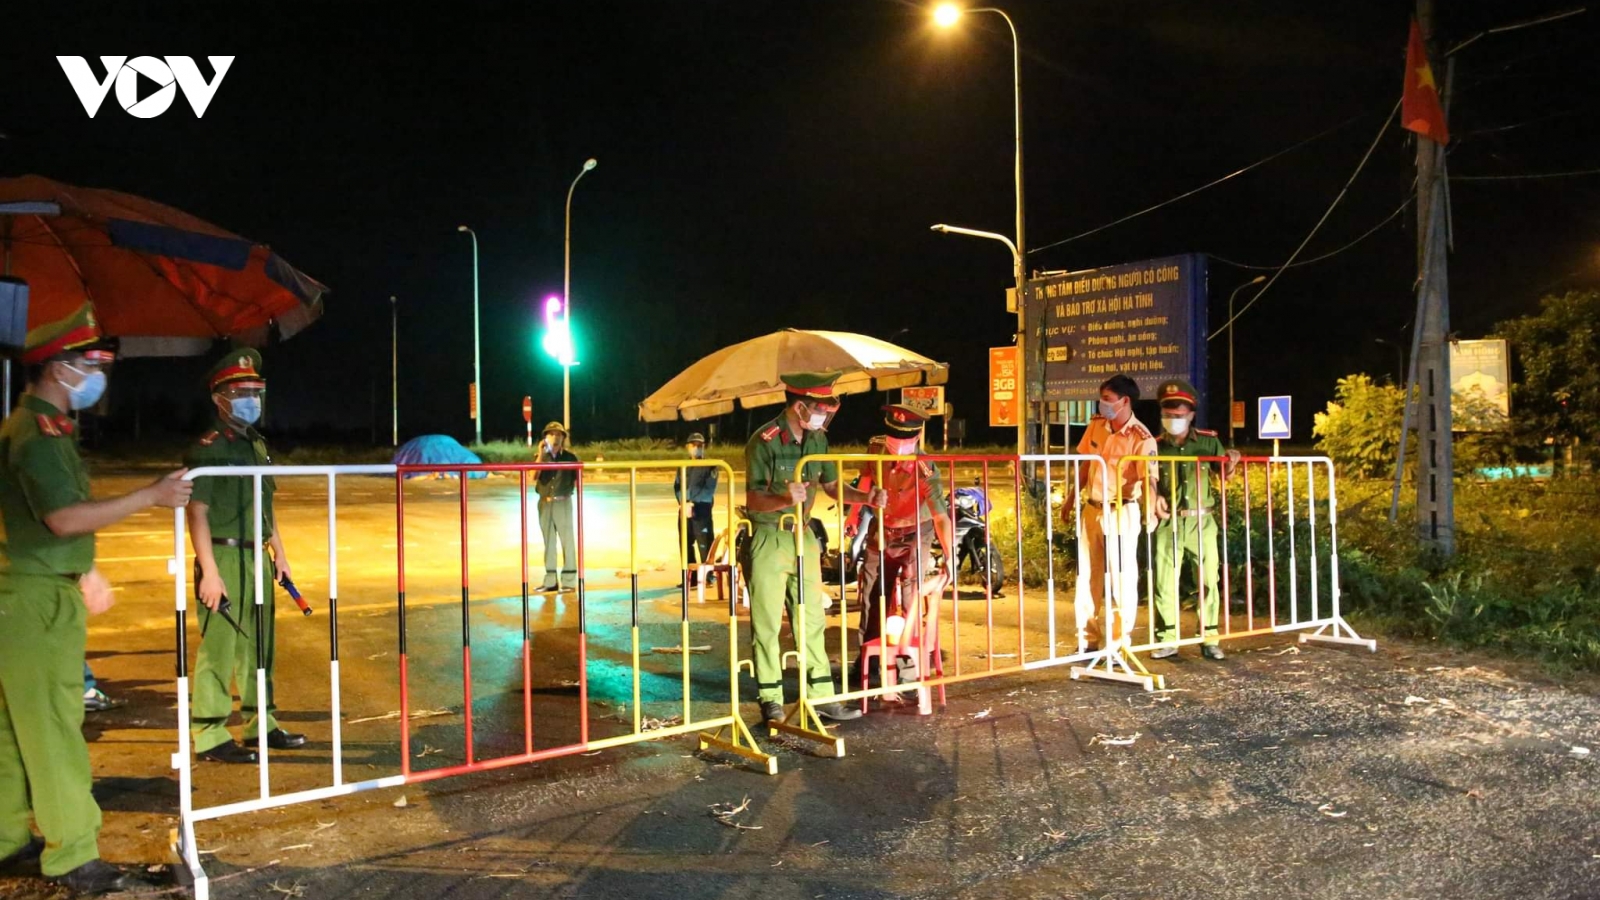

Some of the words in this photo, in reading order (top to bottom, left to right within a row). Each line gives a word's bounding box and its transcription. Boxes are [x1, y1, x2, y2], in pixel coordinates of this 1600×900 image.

[1035, 284, 1057, 300] TRNG
[1058, 280, 1073, 297] TÂM
[1156, 264, 1179, 282] CÔNG
[1056, 301, 1066, 318] VÀ
[1082, 299, 1096, 317] TRỢ
[1108, 294, 1121, 315] HỘI
[993, 378, 1015, 391] 3GB
